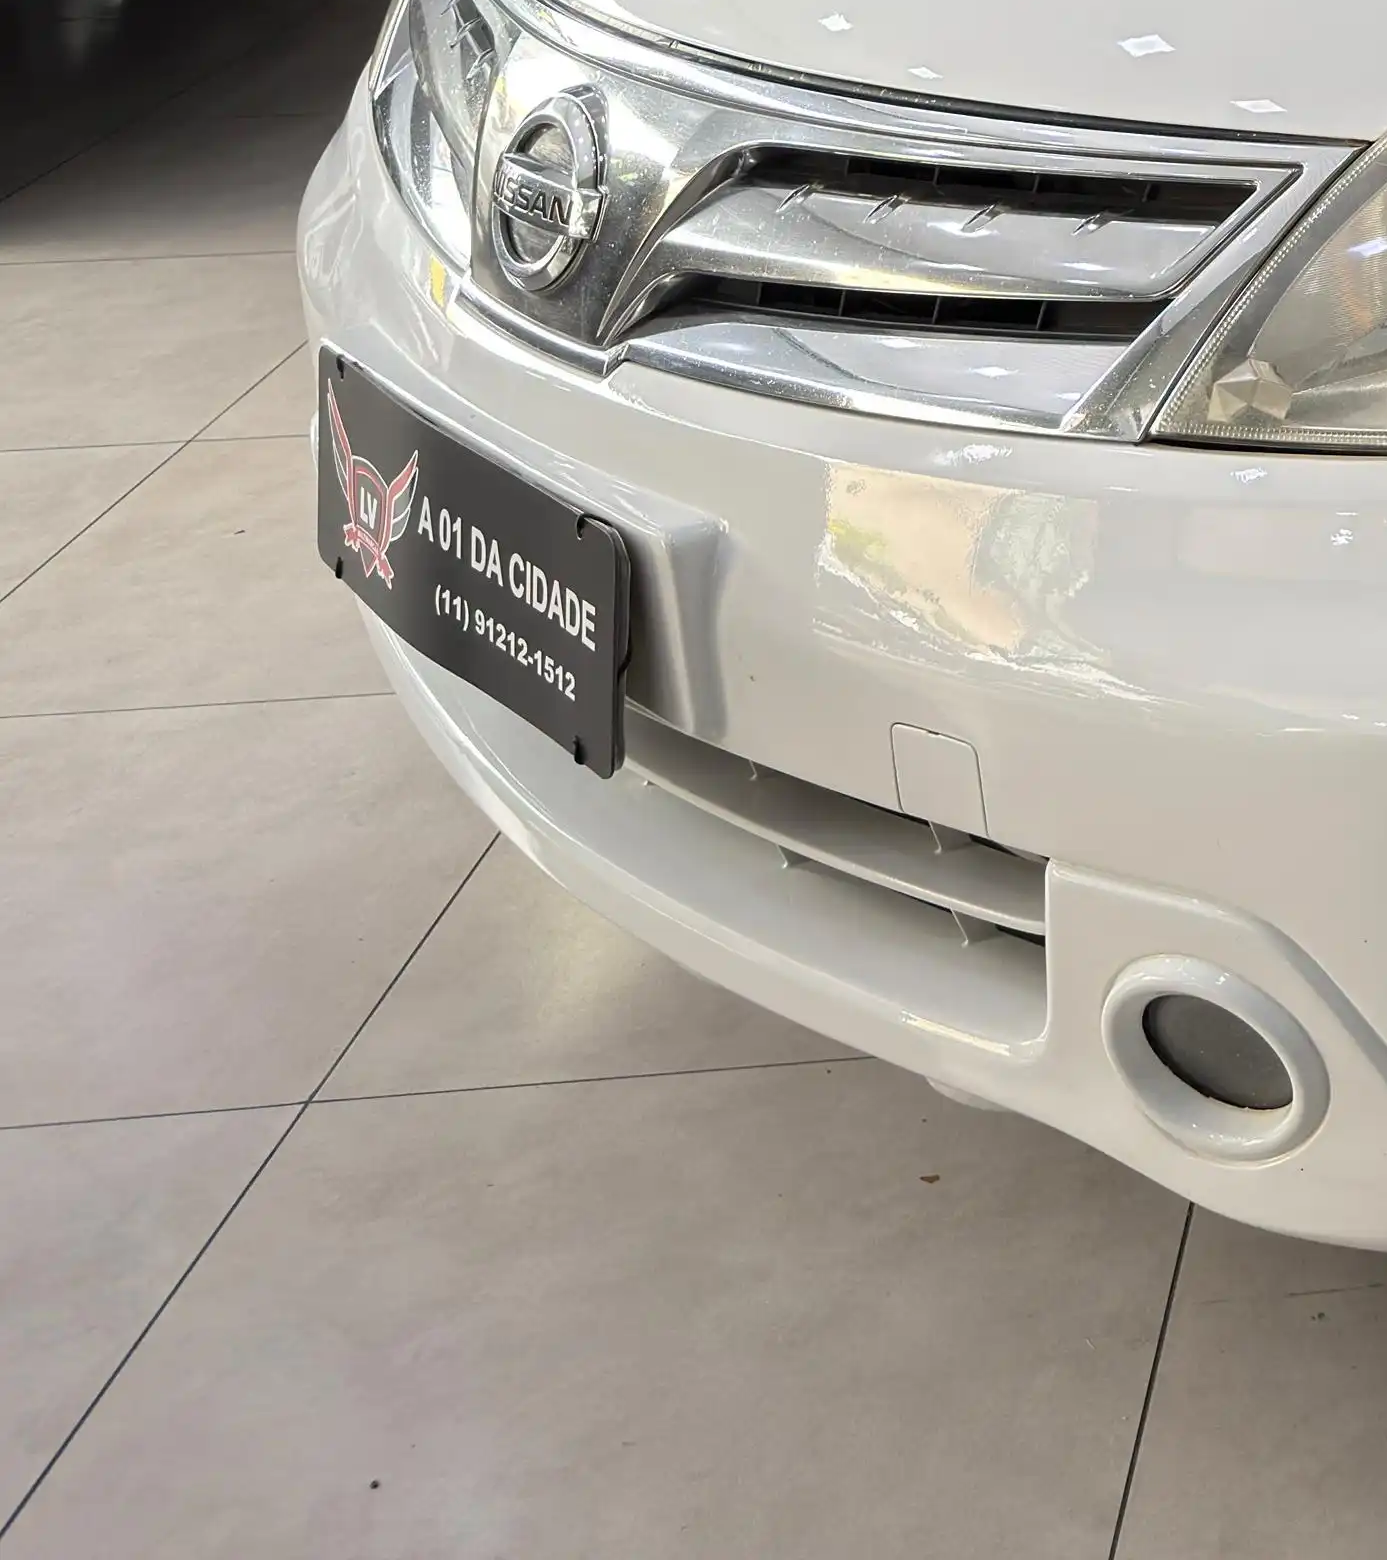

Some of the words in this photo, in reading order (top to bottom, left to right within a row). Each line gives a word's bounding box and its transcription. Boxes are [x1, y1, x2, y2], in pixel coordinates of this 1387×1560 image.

[360, 486, 378, 530] LV
[417, 496, 434, 543] A
[439, 508, 462, 559] 01
[471, 525, 503, 587] DA
[509, 552, 596, 652] CIDADE
[435, 584, 470, 632] (11)
[475, 609, 576, 702] 91212-1512
